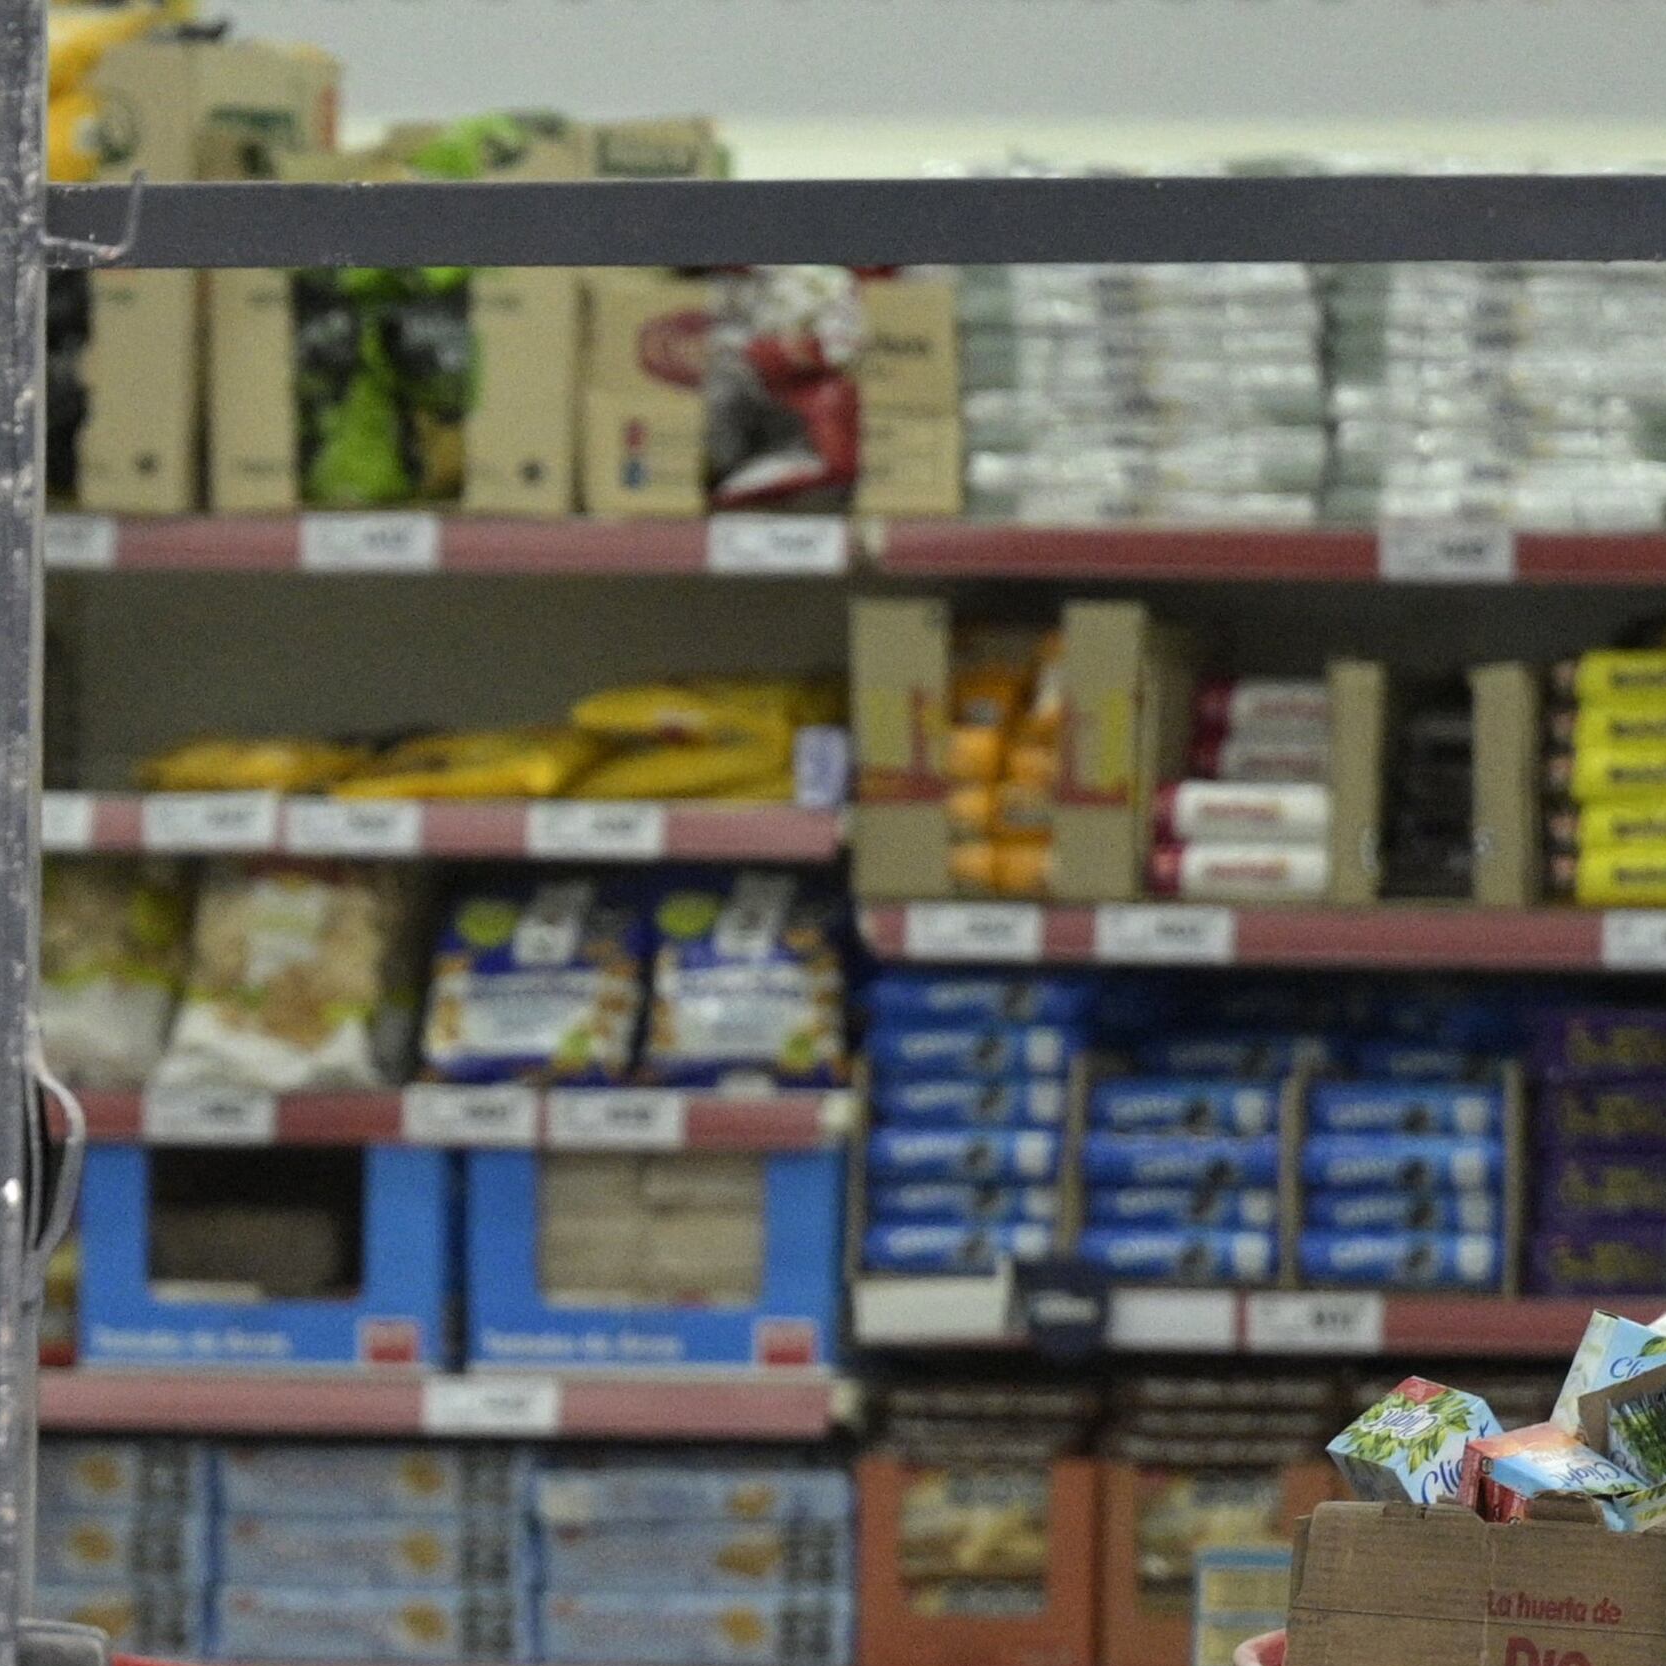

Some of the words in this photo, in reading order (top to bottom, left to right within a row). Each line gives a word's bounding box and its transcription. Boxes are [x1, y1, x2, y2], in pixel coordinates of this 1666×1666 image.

[1609, 1356, 1645, 1379] Cli
[1487, 1588, 1511, 1616] La
[1517, 1591, 1586, 1623] huerta
[1593, 1597, 1622, 1625] de
